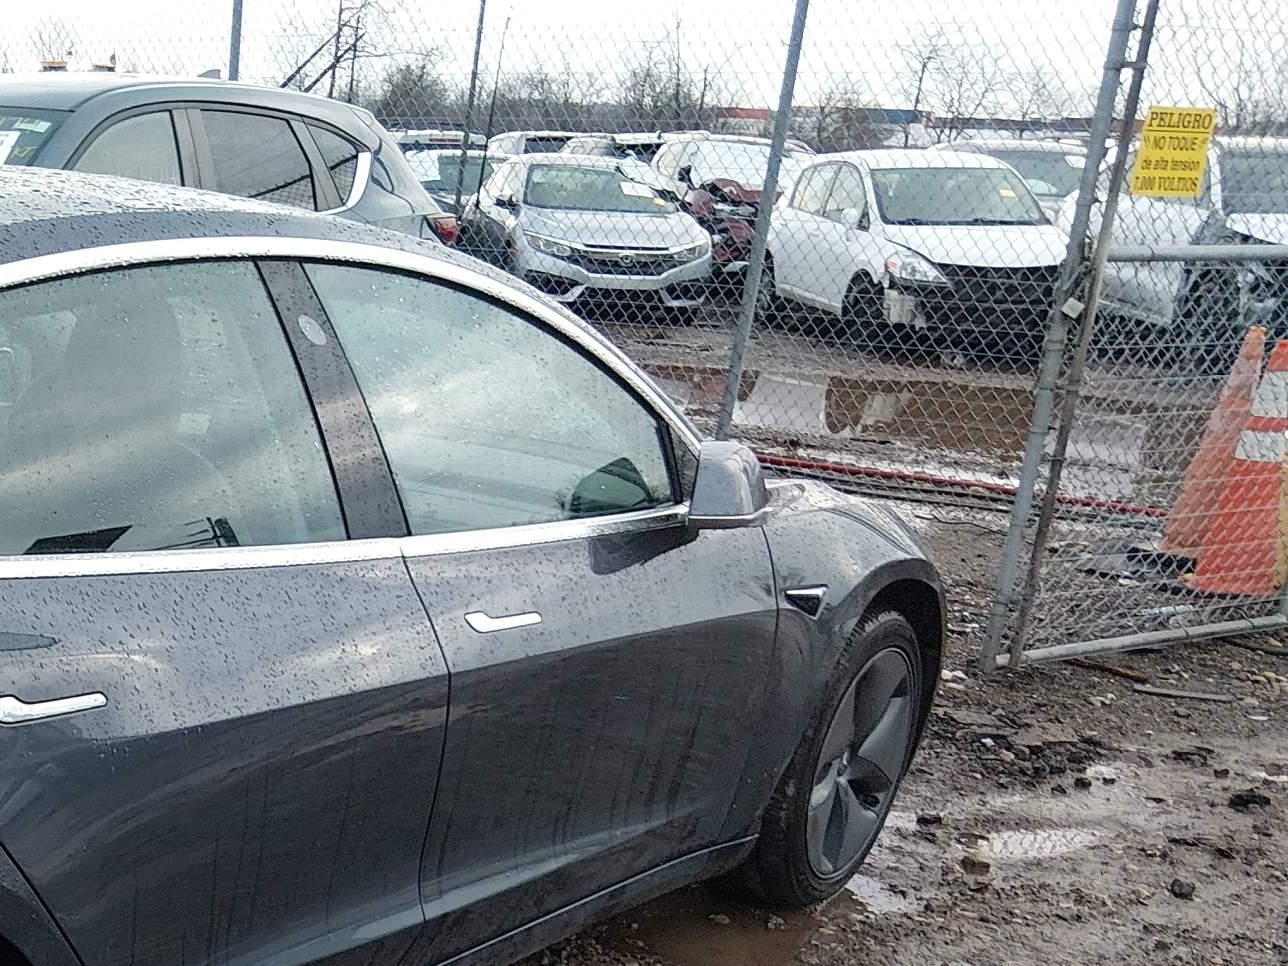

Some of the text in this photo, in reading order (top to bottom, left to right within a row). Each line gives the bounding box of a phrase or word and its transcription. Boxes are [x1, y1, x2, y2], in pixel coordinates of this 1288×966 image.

[1147, 111, 1213, 130] PELIGRO
[1152, 135, 1199, 151] NO TOQUE
[1141, 155, 1152, 170] de
[1153, 155, 1169, 171] alta
